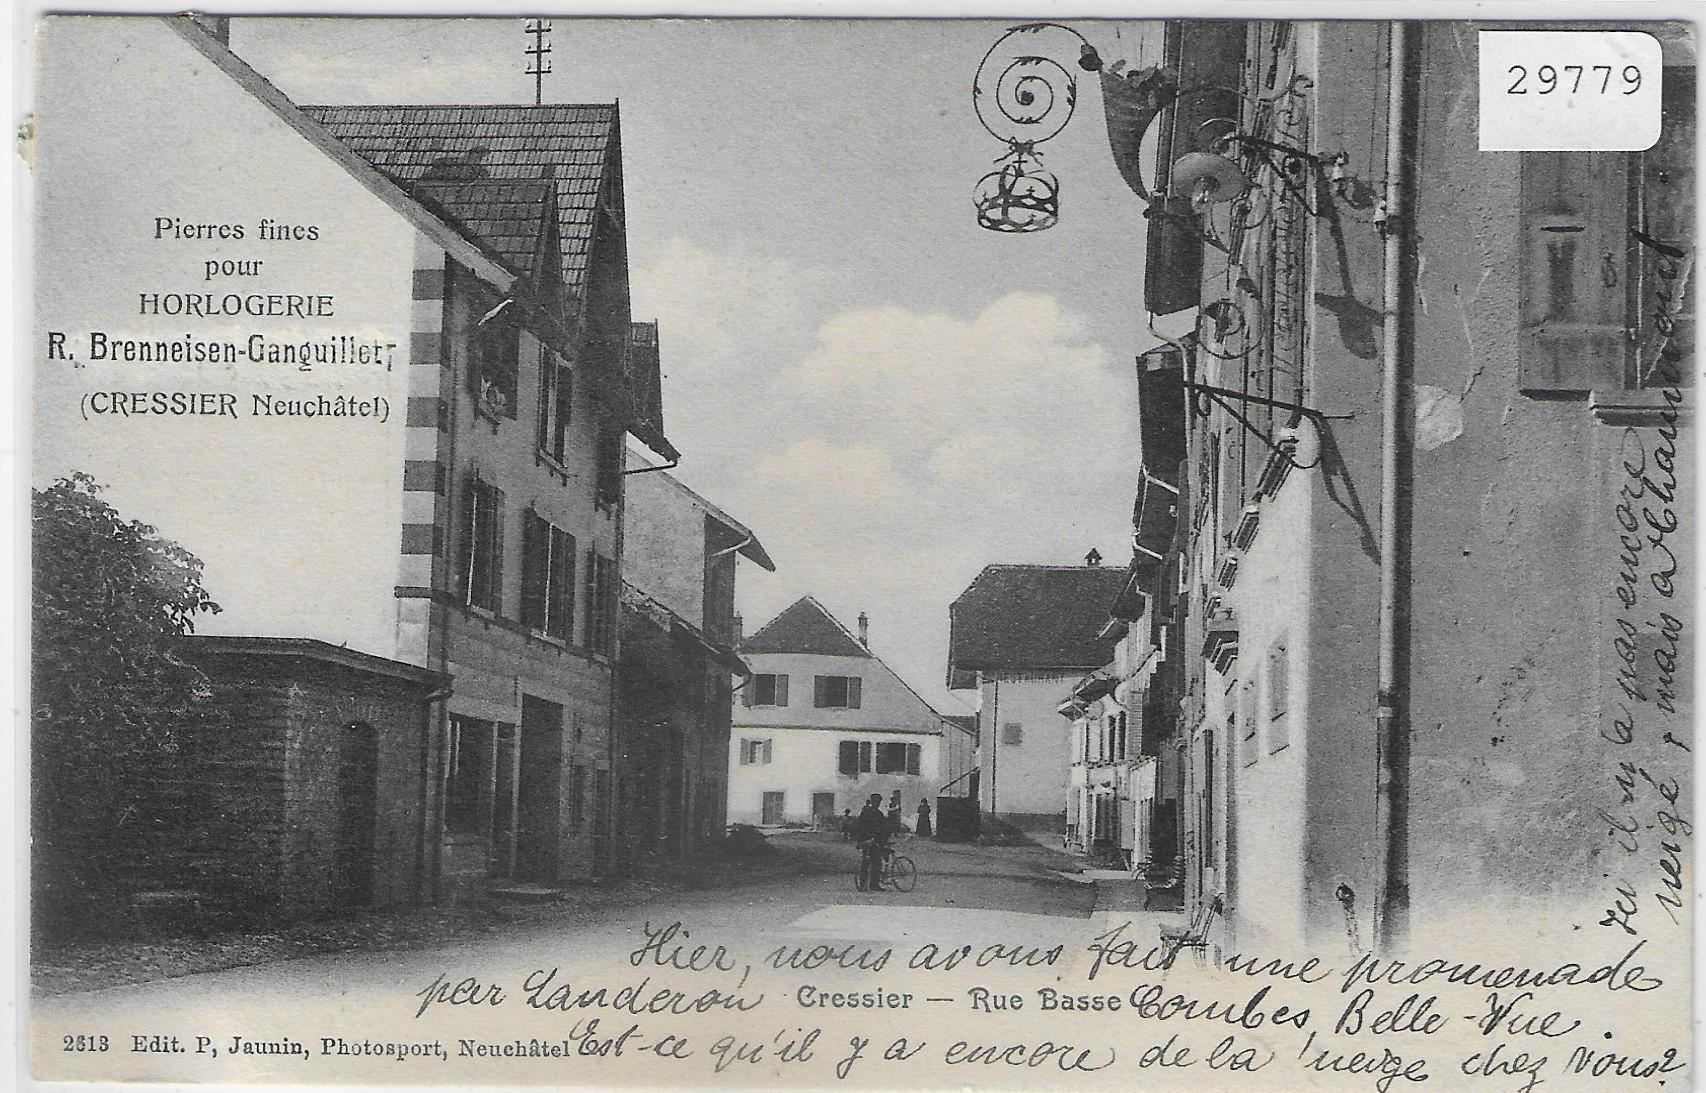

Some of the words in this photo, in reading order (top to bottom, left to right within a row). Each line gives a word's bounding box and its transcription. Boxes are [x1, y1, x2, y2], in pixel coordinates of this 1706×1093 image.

[1507, 64, 1644, 96] 29779
[1613, 427, 1646, 611] encore
[1613, 618, 1647, 703] pas
[1646, 613, 1684, 716] mais
[415, 973, 507, 1018] par
[523, 967, 764, 1015] Landeron
[630, 921, 750, 989] Hier,
[765, 944, 894, 972] nous
[908, 943, 1064, 971] avons
[1087, 921, 1209, 980] fait
[1225, 953, 1332, 984] une
[1341, 939, 1663, 993] promenade
[836, 1036, 870, 1080] y
[883, 1037, 926, 1061] a
[944, 1040, 1117, 1072] encore
[1138, 1034, 1198, 1069] de
[1205, 1035, 1275, 1072] la
[1461, 1044, 1548, 1093] chez
